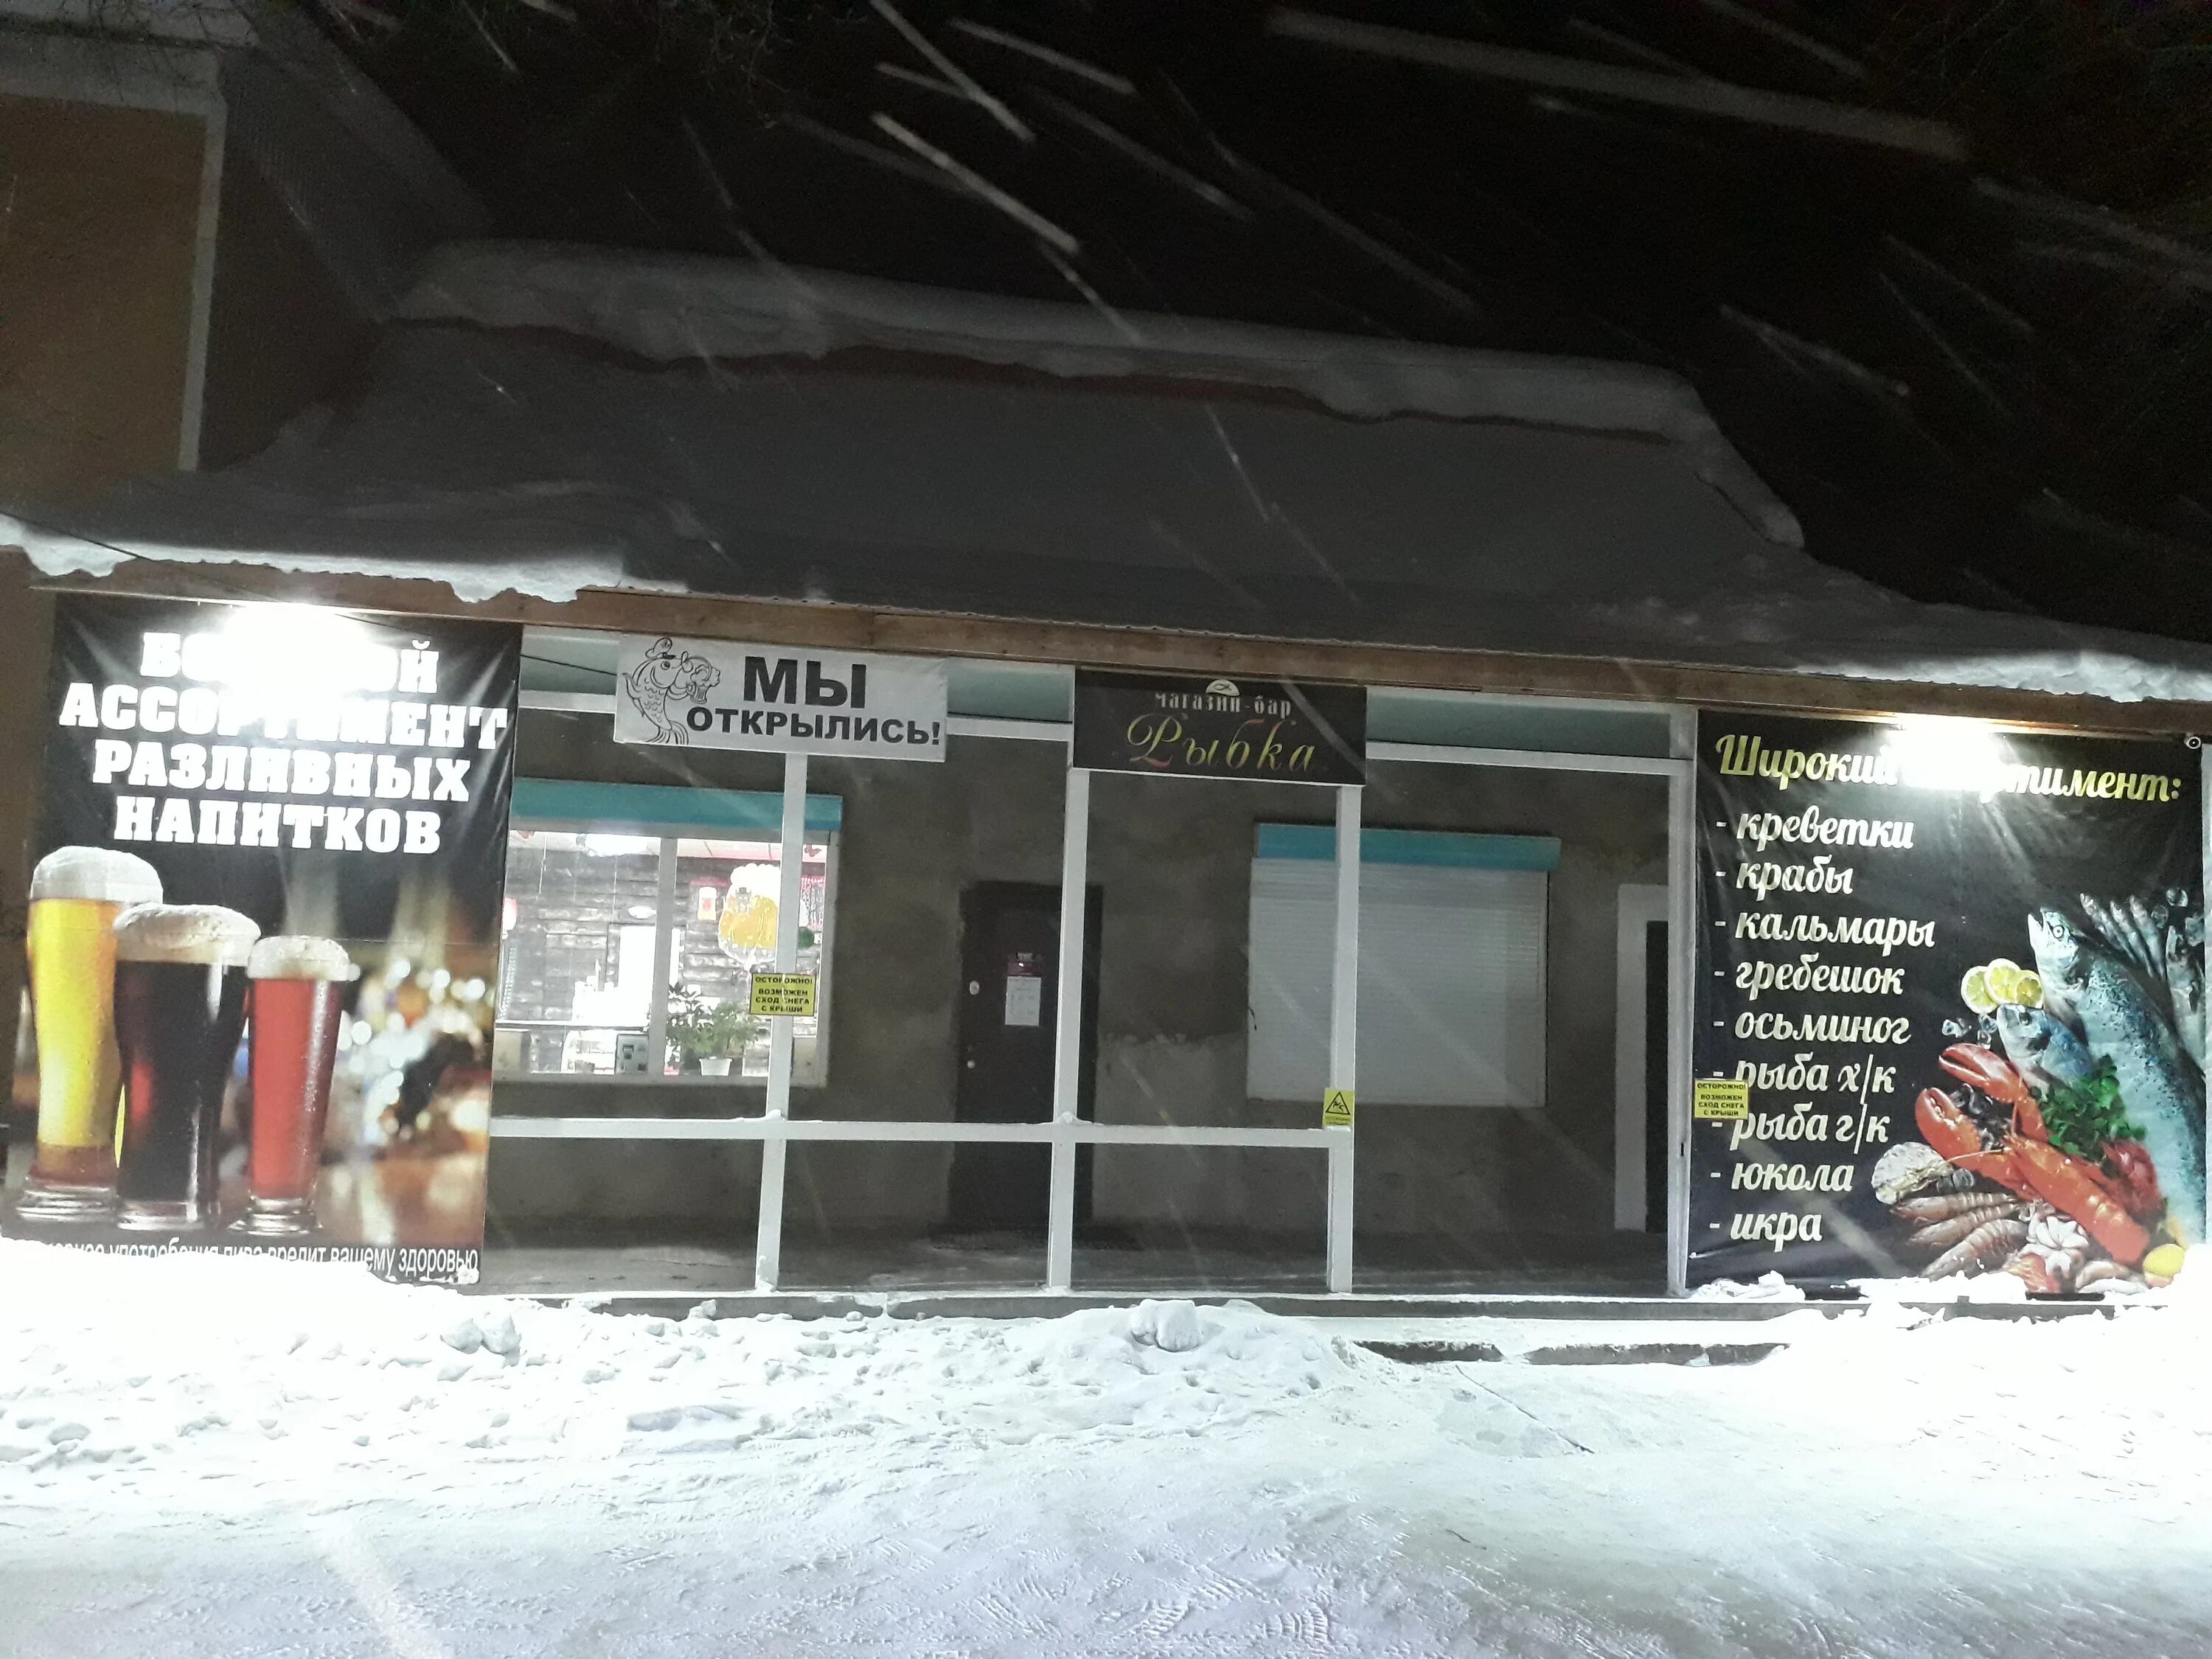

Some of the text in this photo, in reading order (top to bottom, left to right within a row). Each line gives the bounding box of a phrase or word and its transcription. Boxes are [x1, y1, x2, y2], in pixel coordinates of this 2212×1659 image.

[140, 631, 440, 694] БООЙ
[743, 655, 866, 709] МЫ
[59, 683, 508, 750] АССОМЕНТ
[686, 706, 940, 745] ОТКРЫЛИСЬ!
[1127, 712, 1315, 772] Рыбка
[91, 739, 471, 802] РАЗЛИВНЫХ
[1715, 734, 2181, 804] Широкий тимент:
[113, 796, 441, 855] НАПИТКОВ
[1736, 804, 1914, 852] креветки
[1736, 854, 1854, 901] крабы
[1735, 912, 1935, 956] кальмары
[758, 988, 808, 996] ВОЗМОЖЕН
[1735, 952, 1905, 1001] гребешок
[1734, 1012, 1911, 1045] осьминог
[1735, 1051, 1829, 1091] рыба
[1729, 1101, 1829, 1151] рыба
[1731, 1162, 1854, 1192] юкола
[1730, 1212, 1823, 1253] икра
[399, 1248, 479, 1280] здоровью
